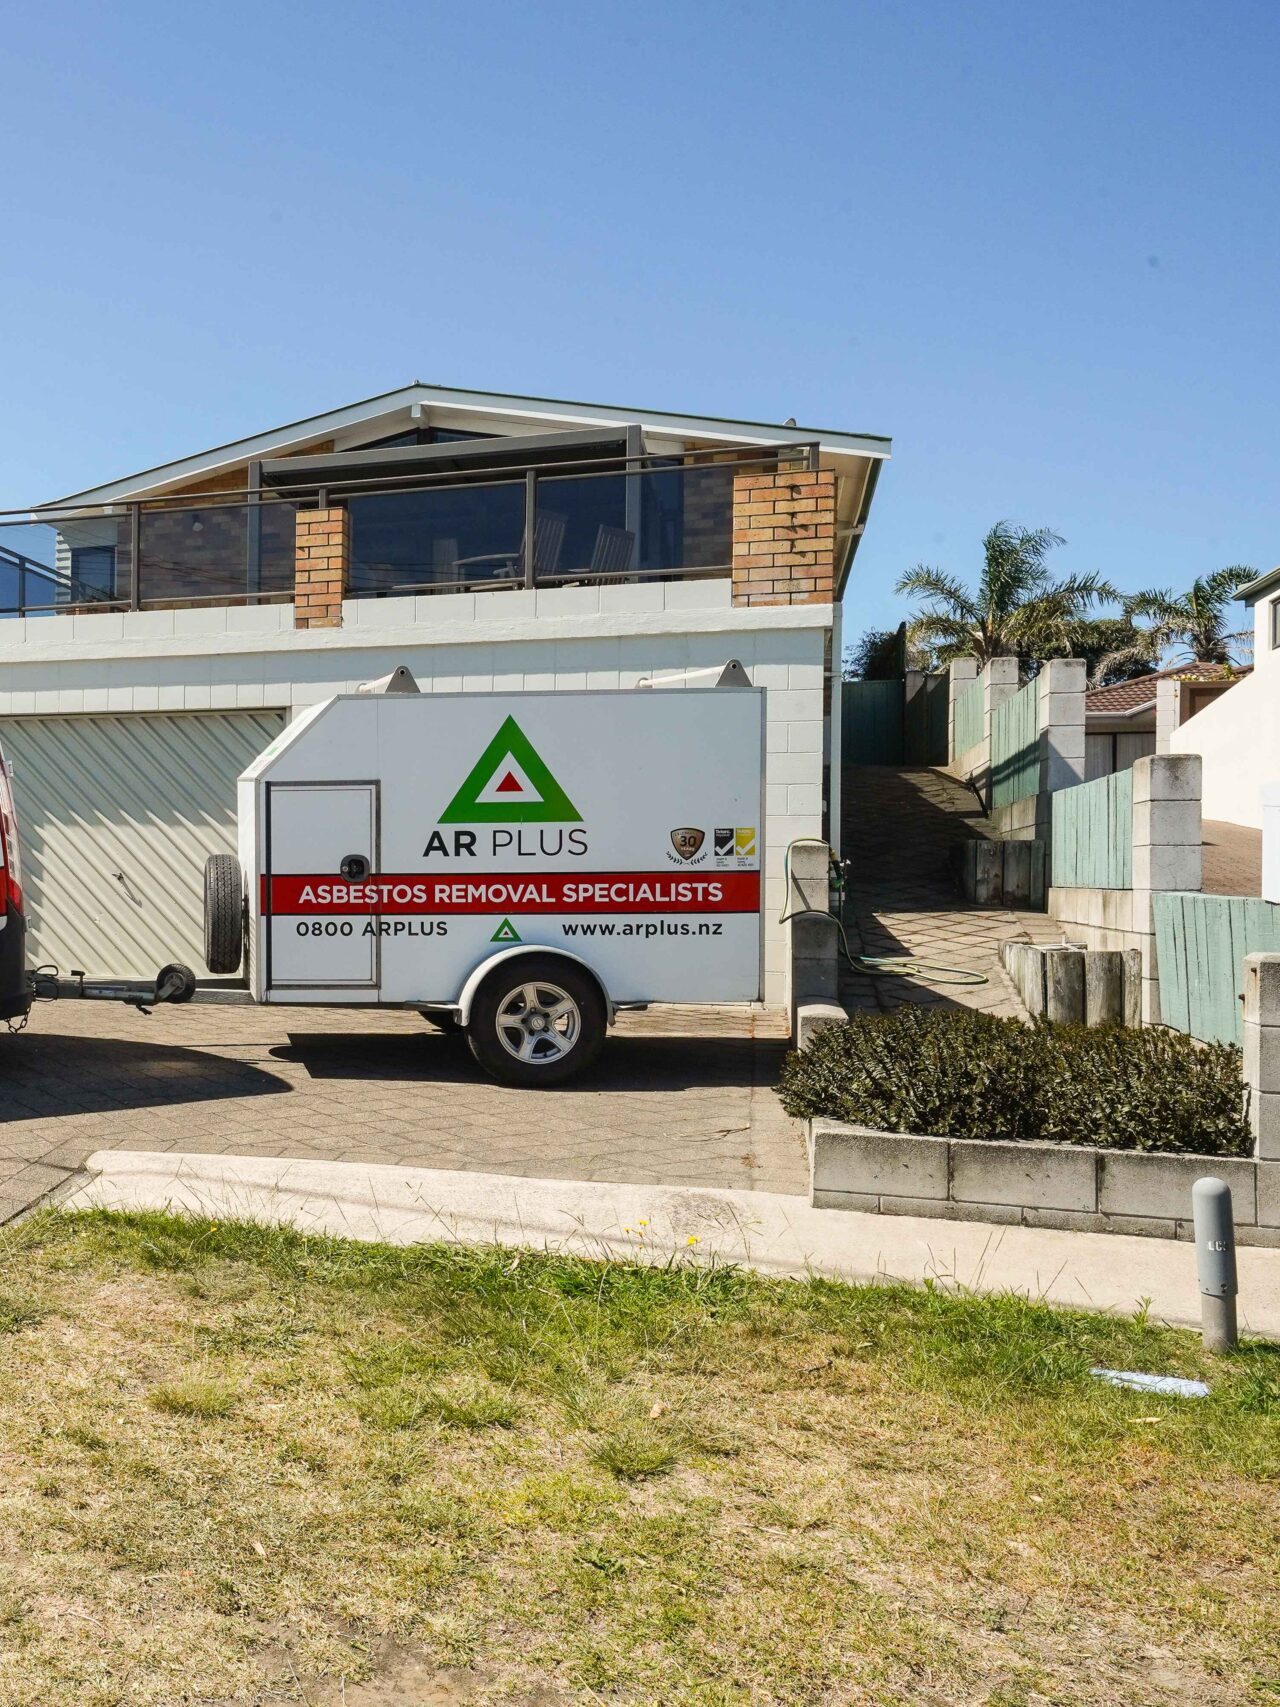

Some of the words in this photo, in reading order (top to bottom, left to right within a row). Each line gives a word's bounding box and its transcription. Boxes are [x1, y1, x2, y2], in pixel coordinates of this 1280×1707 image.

[422, 830, 478, 858] AR
[492, 829, 589, 857] PLUS
[679, 835, 697, 847] 30
[298, 884, 427, 904] ASBESTOS
[434, 884, 556, 903] REMOVAL
[562, 882, 723, 903] SPECIALISTS
[295, 921, 354, 937] 0800
[361, 921, 448, 937] ARPLUS
[561, 919, 723, 939] www.arplus.nz
